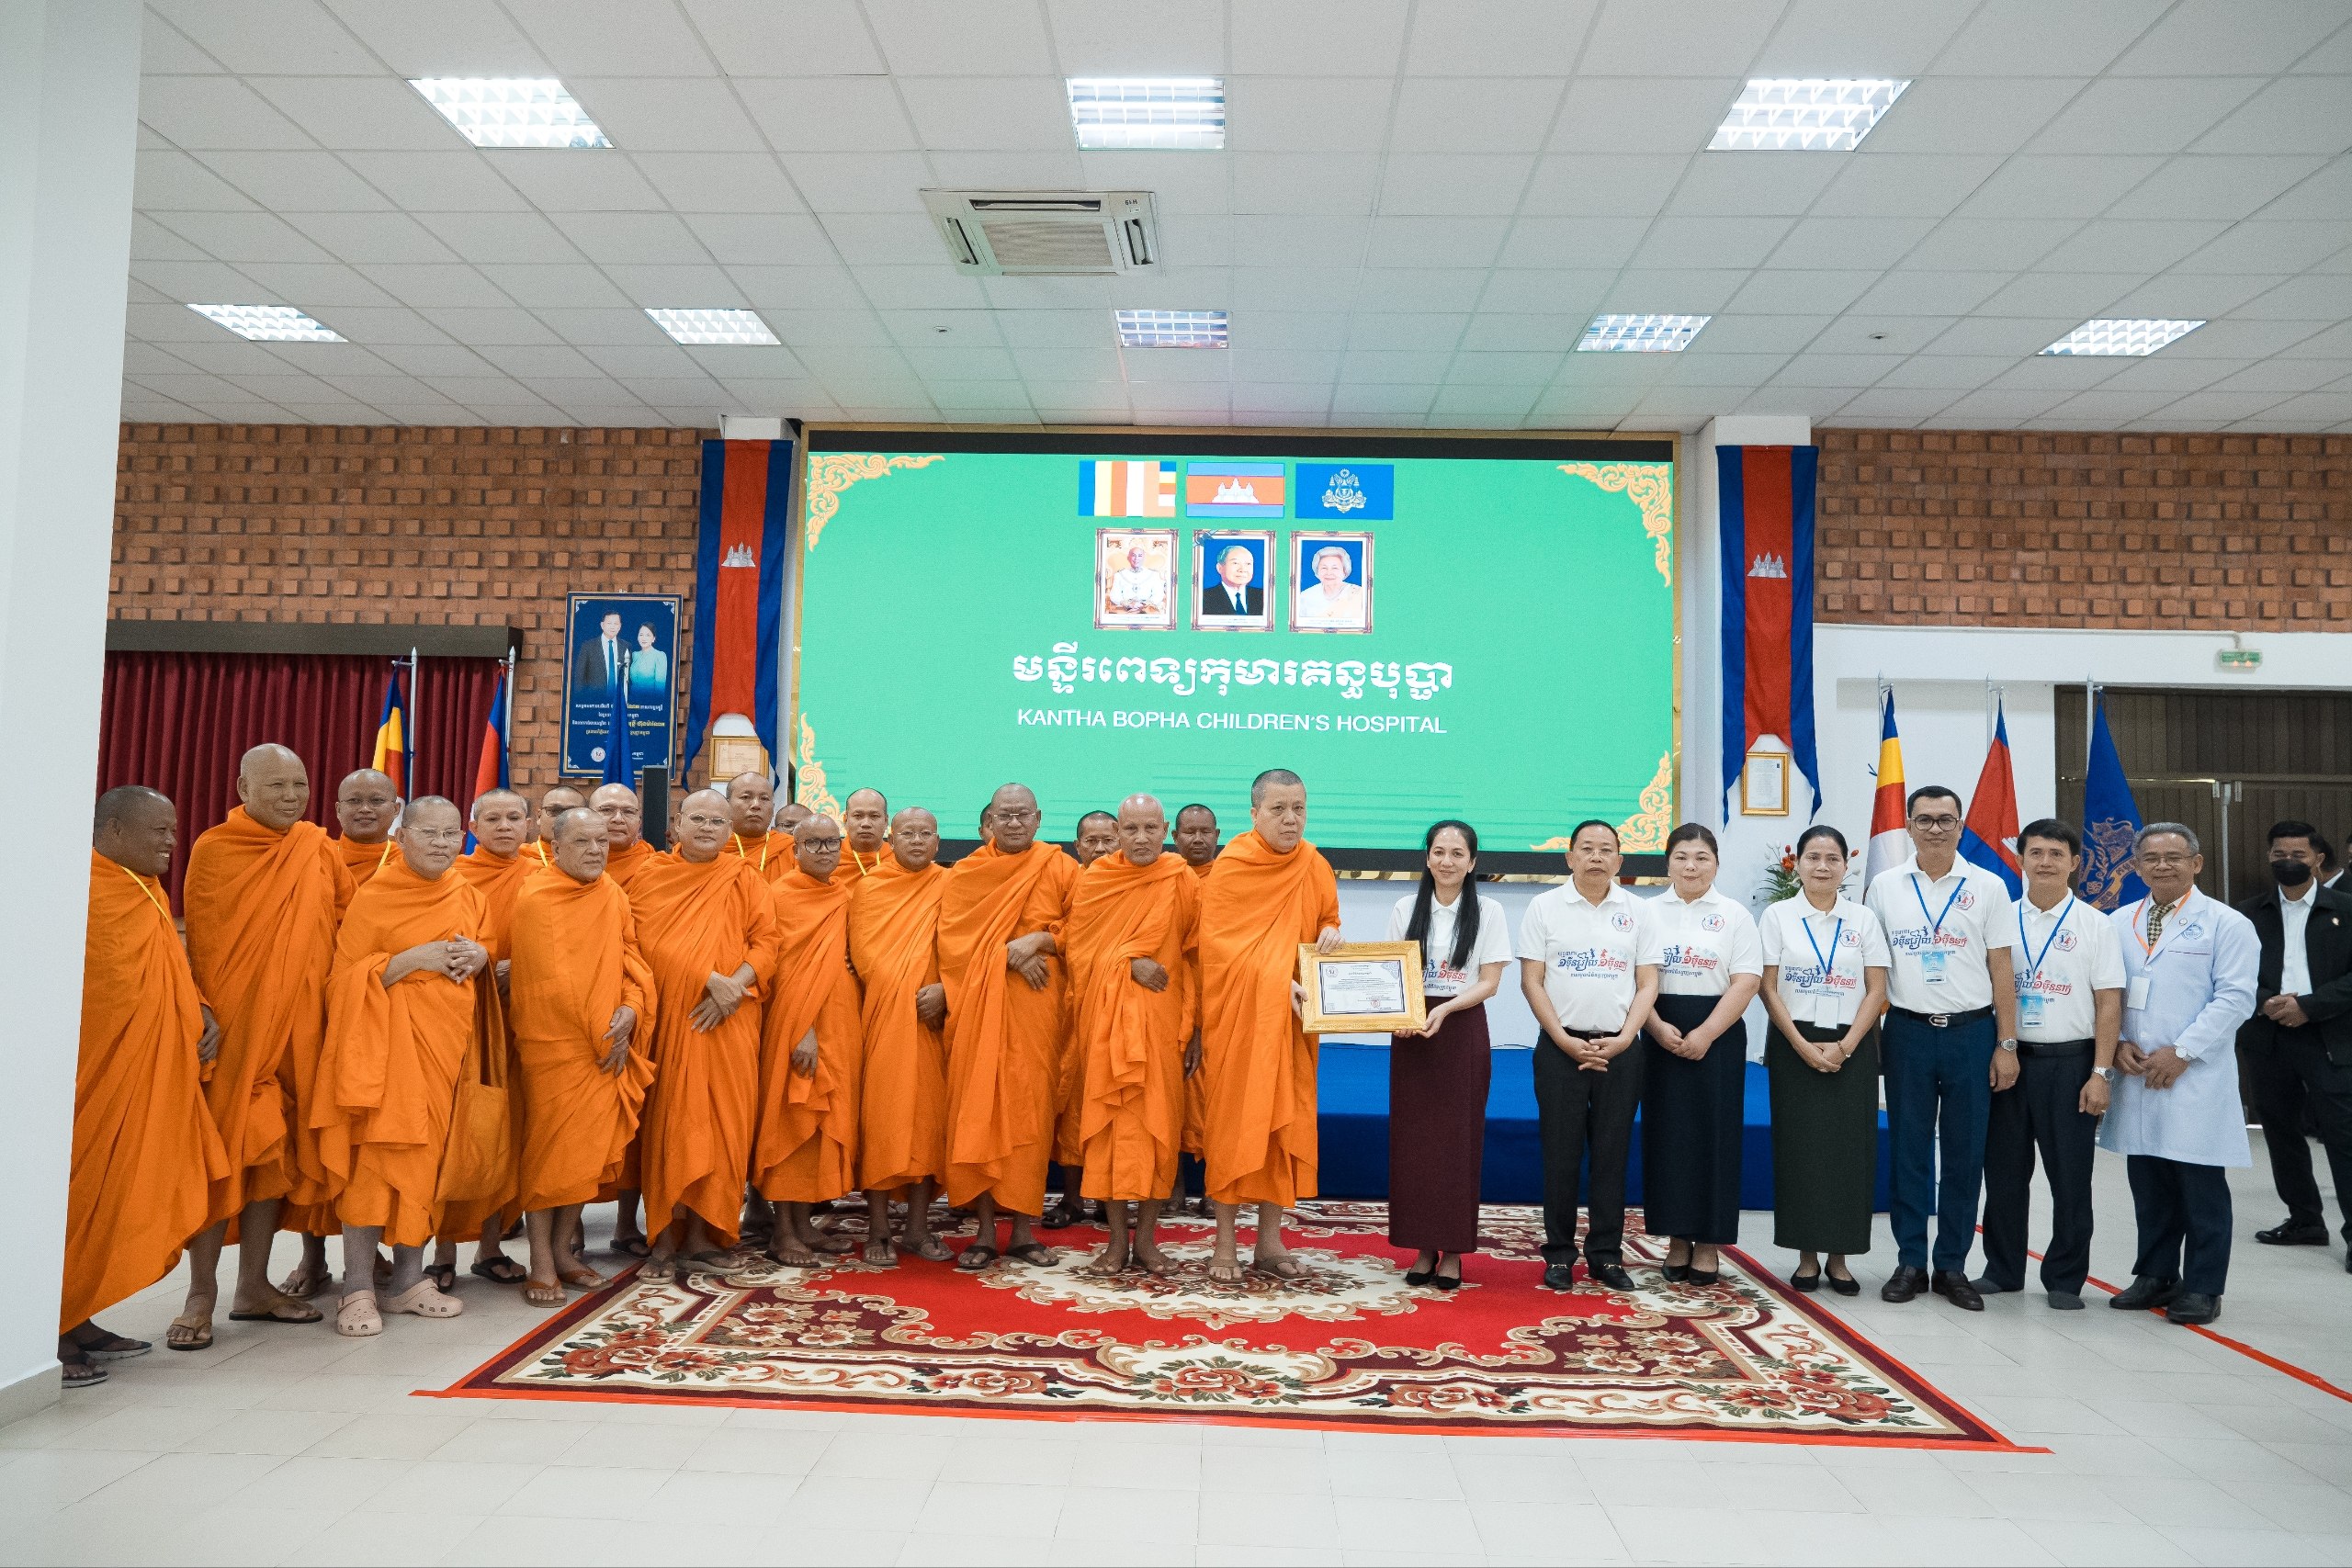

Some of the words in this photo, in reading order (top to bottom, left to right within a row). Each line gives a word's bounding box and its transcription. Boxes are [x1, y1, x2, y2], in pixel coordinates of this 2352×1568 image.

[1018, 708, 1107, 727] KANTHA
[1113, 710, 1191, 728] BOPHA
[1337, 715, 1447, 734] HOSPITAL
